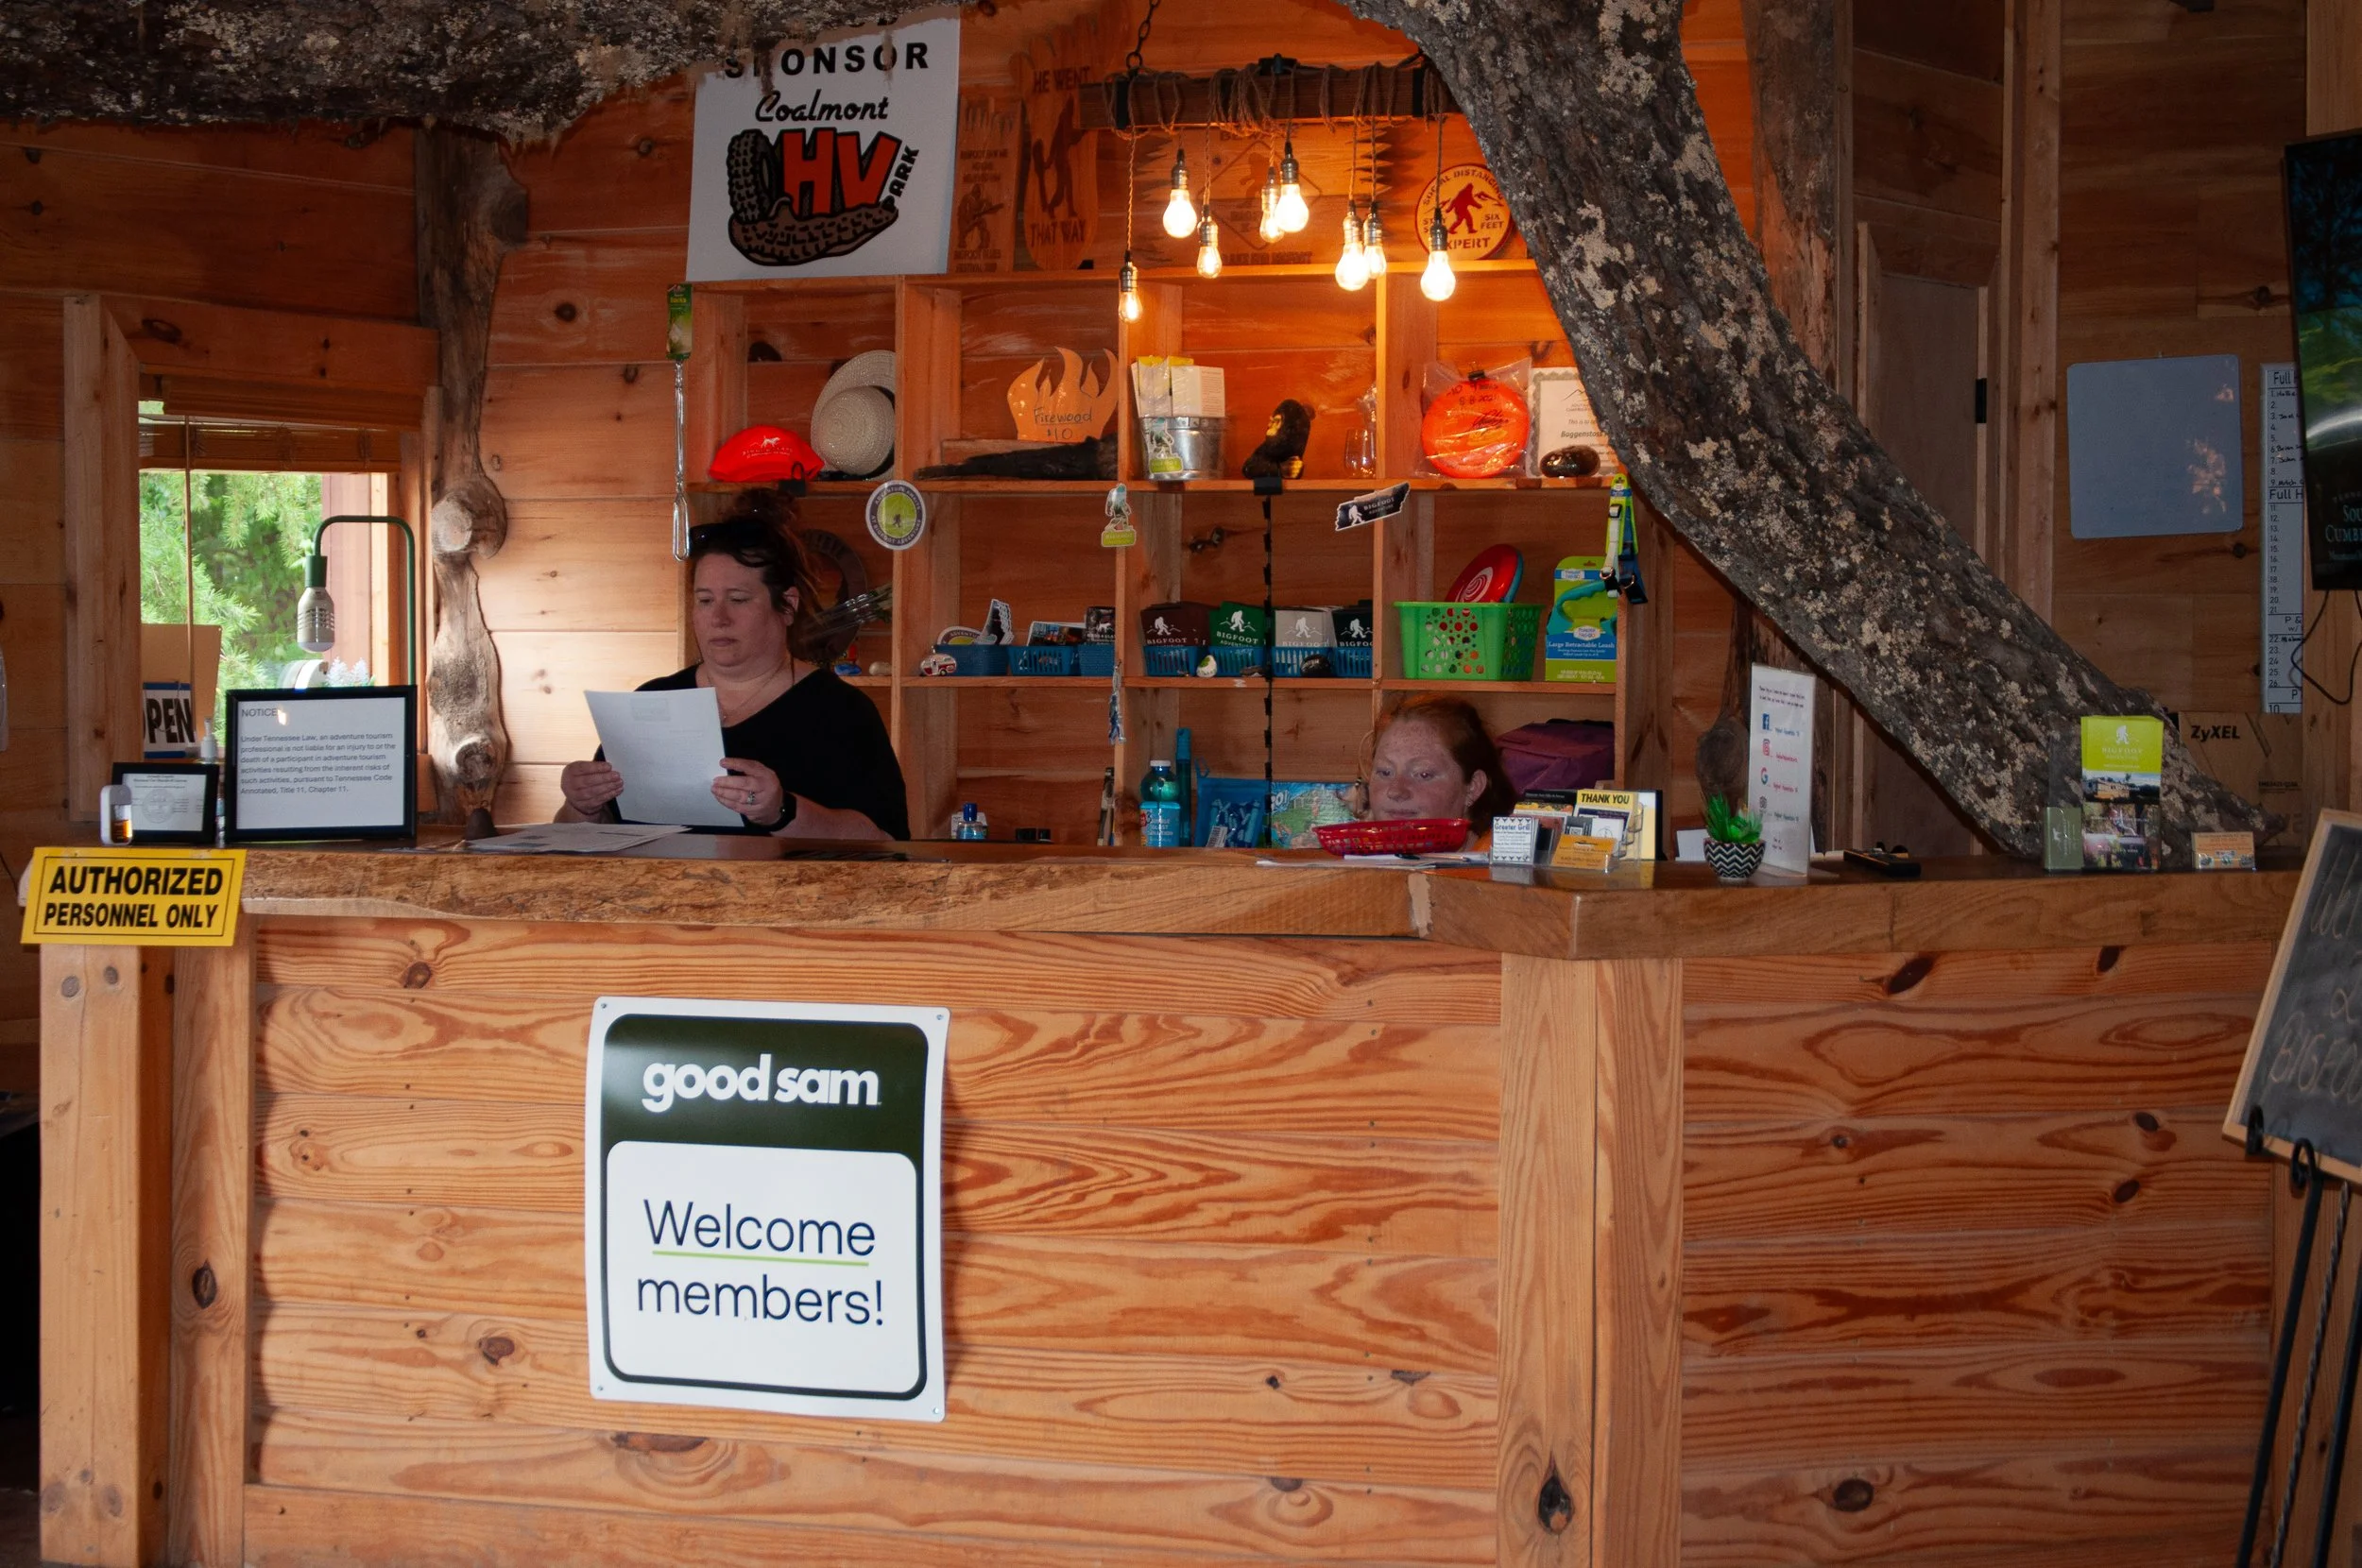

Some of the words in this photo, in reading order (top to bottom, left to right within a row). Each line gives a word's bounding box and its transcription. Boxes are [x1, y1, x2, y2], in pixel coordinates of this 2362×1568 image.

[725, 42, 929, 78] SONSOR
[1034, 71, 1051, 93] HE
[1053, 65, 1091, 91] WENT
[755, 89, 890, 122] Coalmont
[880, 145, 920, 213] PARK
[1423, 175, 1450, 205] SOCAL
[1423, 217, 1446, 226] STY
[1481, 221, 1504, 230] FEET
[1031, 223, 1057, 247] THAT
[1060, 219, 1087, 243] WAY
[1446, 236, 1491, 250] XPERT
[2273, 371, 2291, 385] Full
[1034, 406, 1092, 424] Firewood
[1047, 427, 1073, 440] $10
[2269, 488, 2291, 500] Full
[1216, 630, 1258, 645] BIGFOOT
[142, 698, 196, 743] PEN
[2191, 724, 2241, 742] ZyXEL
[241, 745, 283, 754] professional
[294, 775, 325, 784] pursuant
[1581, 793, 1610, 803] THANK
[1612, 794, 1631, 805] YOU
[49, 866, 223, 895] AUTHORIZED
[43, 902, 159, 928] PERSONNEL
[166, 904, 219, 929] ONLY
[642, 1199, 876, 1257] Welcome
[637, 1273, 884, 1326] members!
